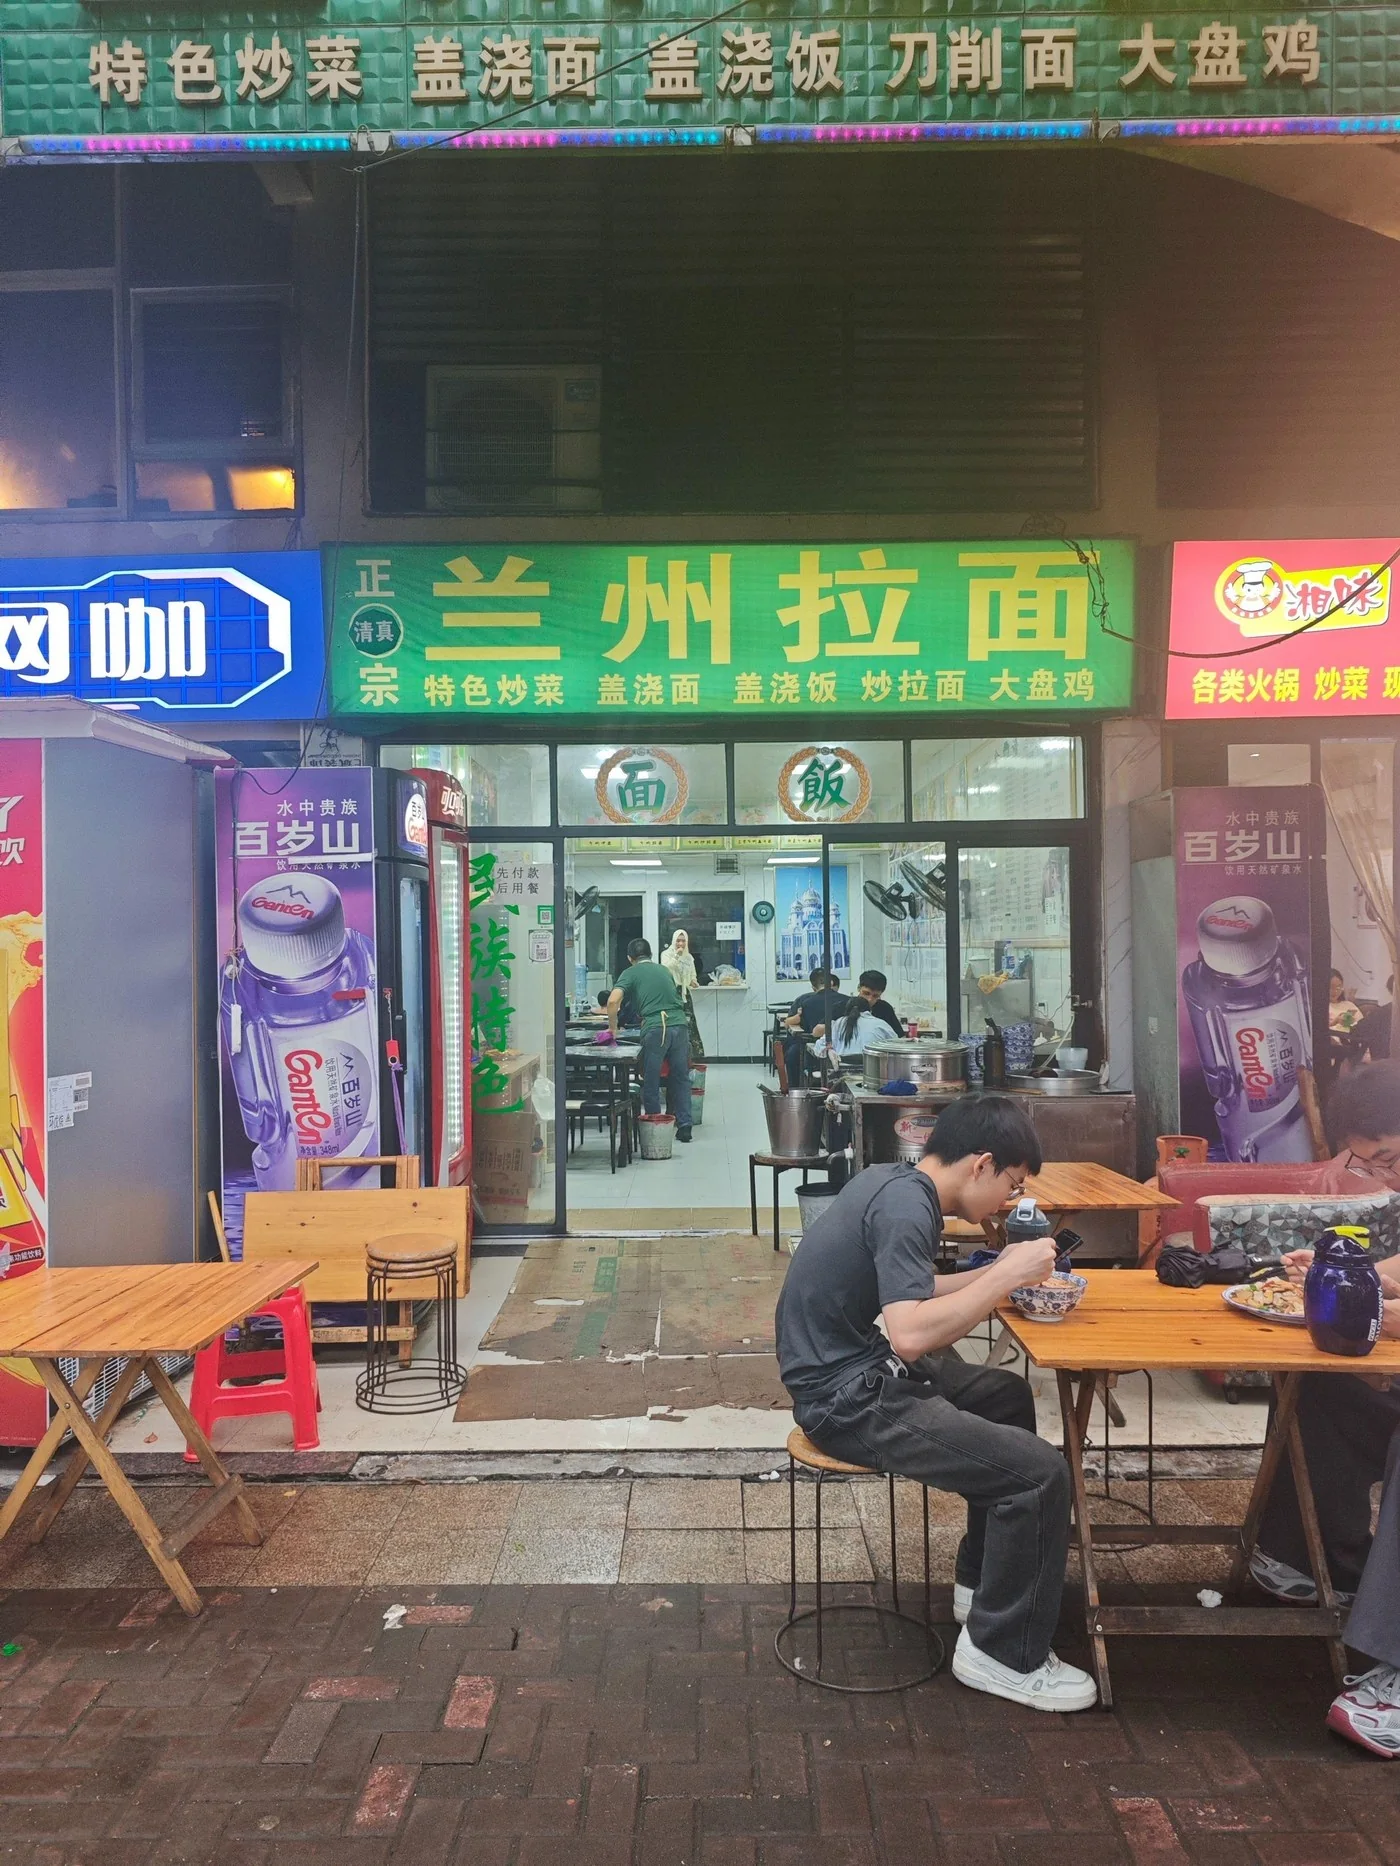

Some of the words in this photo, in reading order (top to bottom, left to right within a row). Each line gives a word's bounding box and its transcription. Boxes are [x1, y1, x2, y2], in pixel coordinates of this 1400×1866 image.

[88, 35, 363, 104] 特色炒菜
[411, 34, 601, 102] 盖浇面
[644, 27, 846, 101] 盖浇饭
[884, 26, 1076, 93] 刀削面
[1118, 19, 1321, 88] 大盘鸡
[354, 559, 395, 598] 正
[425, 548, 1101, 665] 兰州拉面
[353, 619, 394, 643] 清真
[359, 663, 400, 707] 宗
[424, 673, 564, 707] 特色炒菜
[596, 673, 700, 706] 盖浇面
[733, 671, 837, 705] 盖浇饭
[861, 669, 966, 703] 炒拉面
[989, 668, 1095, 702] 大盘鸡
[1192, 667, 1300, 704] 各类火锅
[1313, 666, 1370, 701] 炒菜
[616, 760, 666, 814] 面
[797, 757, 852, 813] 飯
[276, 799, 358, 817] 水中贵族
[1225, 810, 1299, 827] 水中贵族
[231, 820, 360, 857] 百岁山
[1183, 829, 1301, 863] 百岁山
[496, 866, 540, 879] 先付款
[496, 882, 540, 895] 后用餐
[1224, 864, 1302, 876] 饮用天然矿泉水
[342, 1077, 362, 1128] 百岁山
